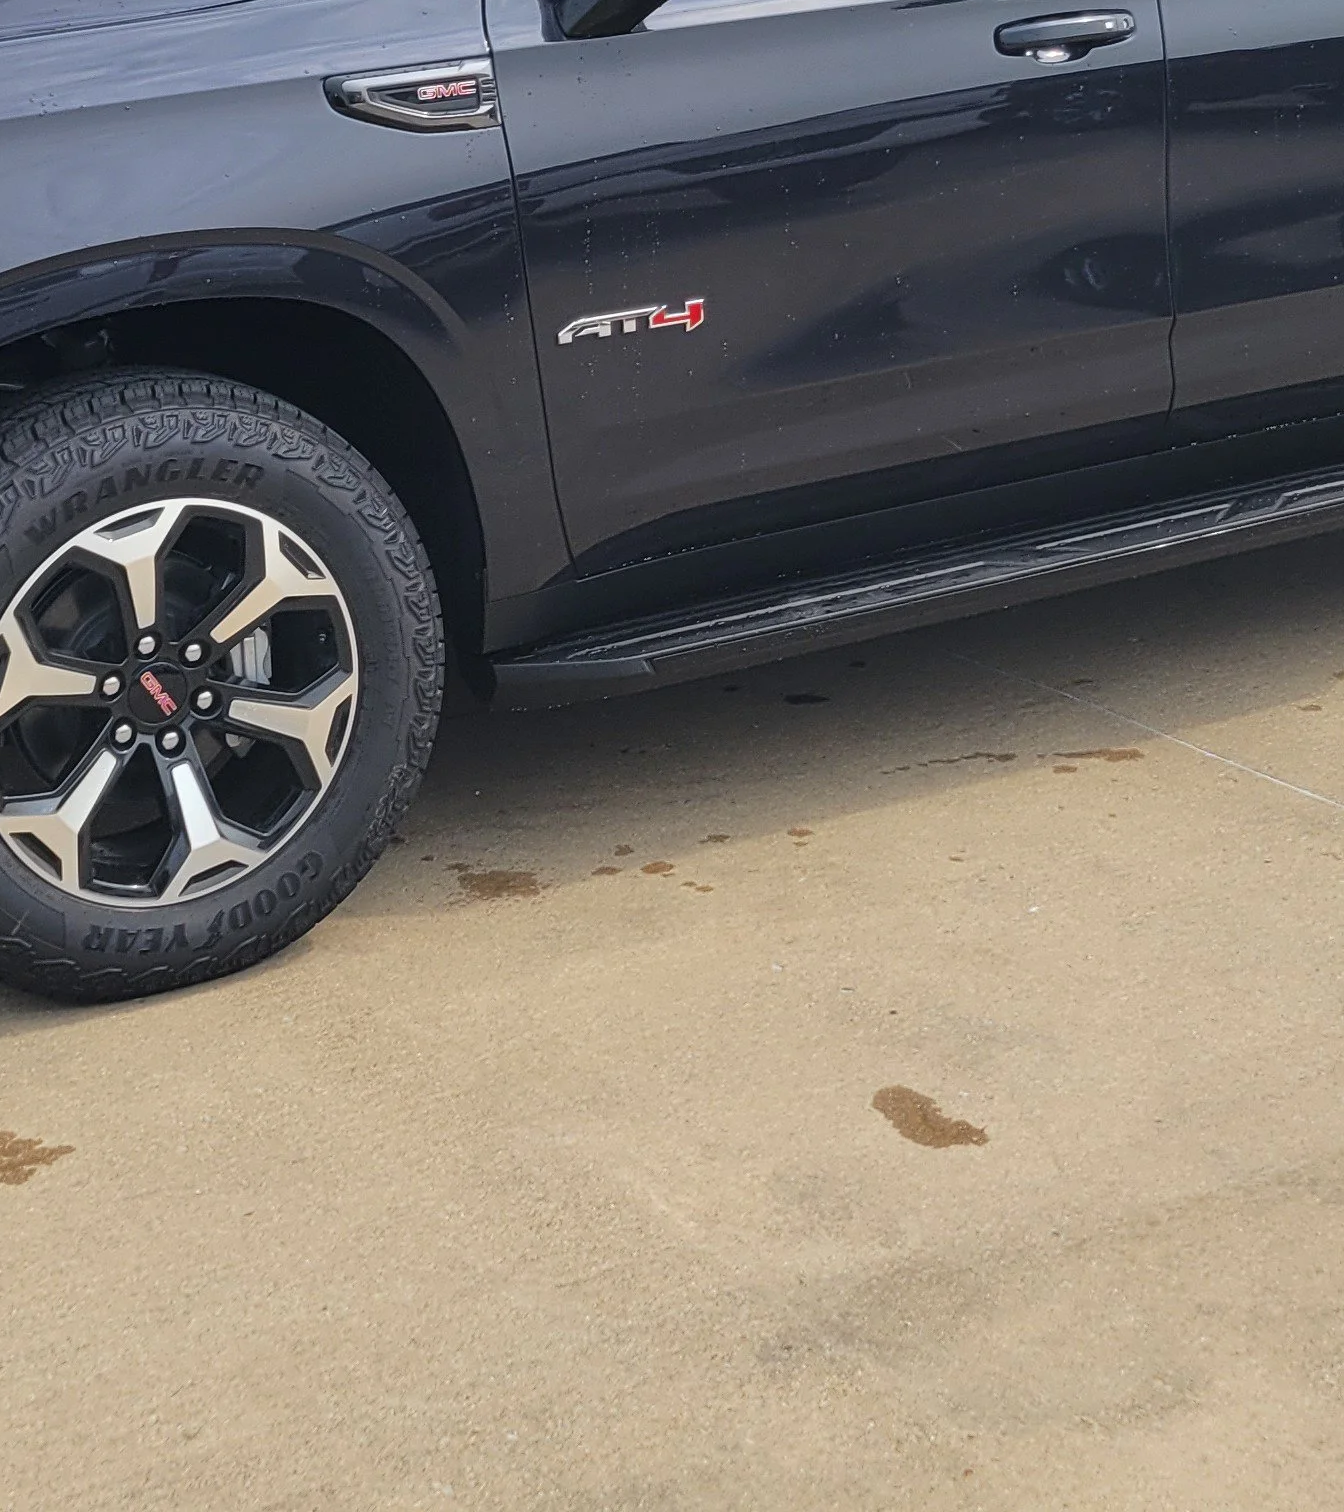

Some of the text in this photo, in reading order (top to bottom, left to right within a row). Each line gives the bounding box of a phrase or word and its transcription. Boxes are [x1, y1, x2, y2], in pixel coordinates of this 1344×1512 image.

[417, 79, 477, 102] GMC
[557, 297, 705, 346] AT4
[25, 457, 266, 543] WRANGLER
[140, 671, 177, 716] GMC
